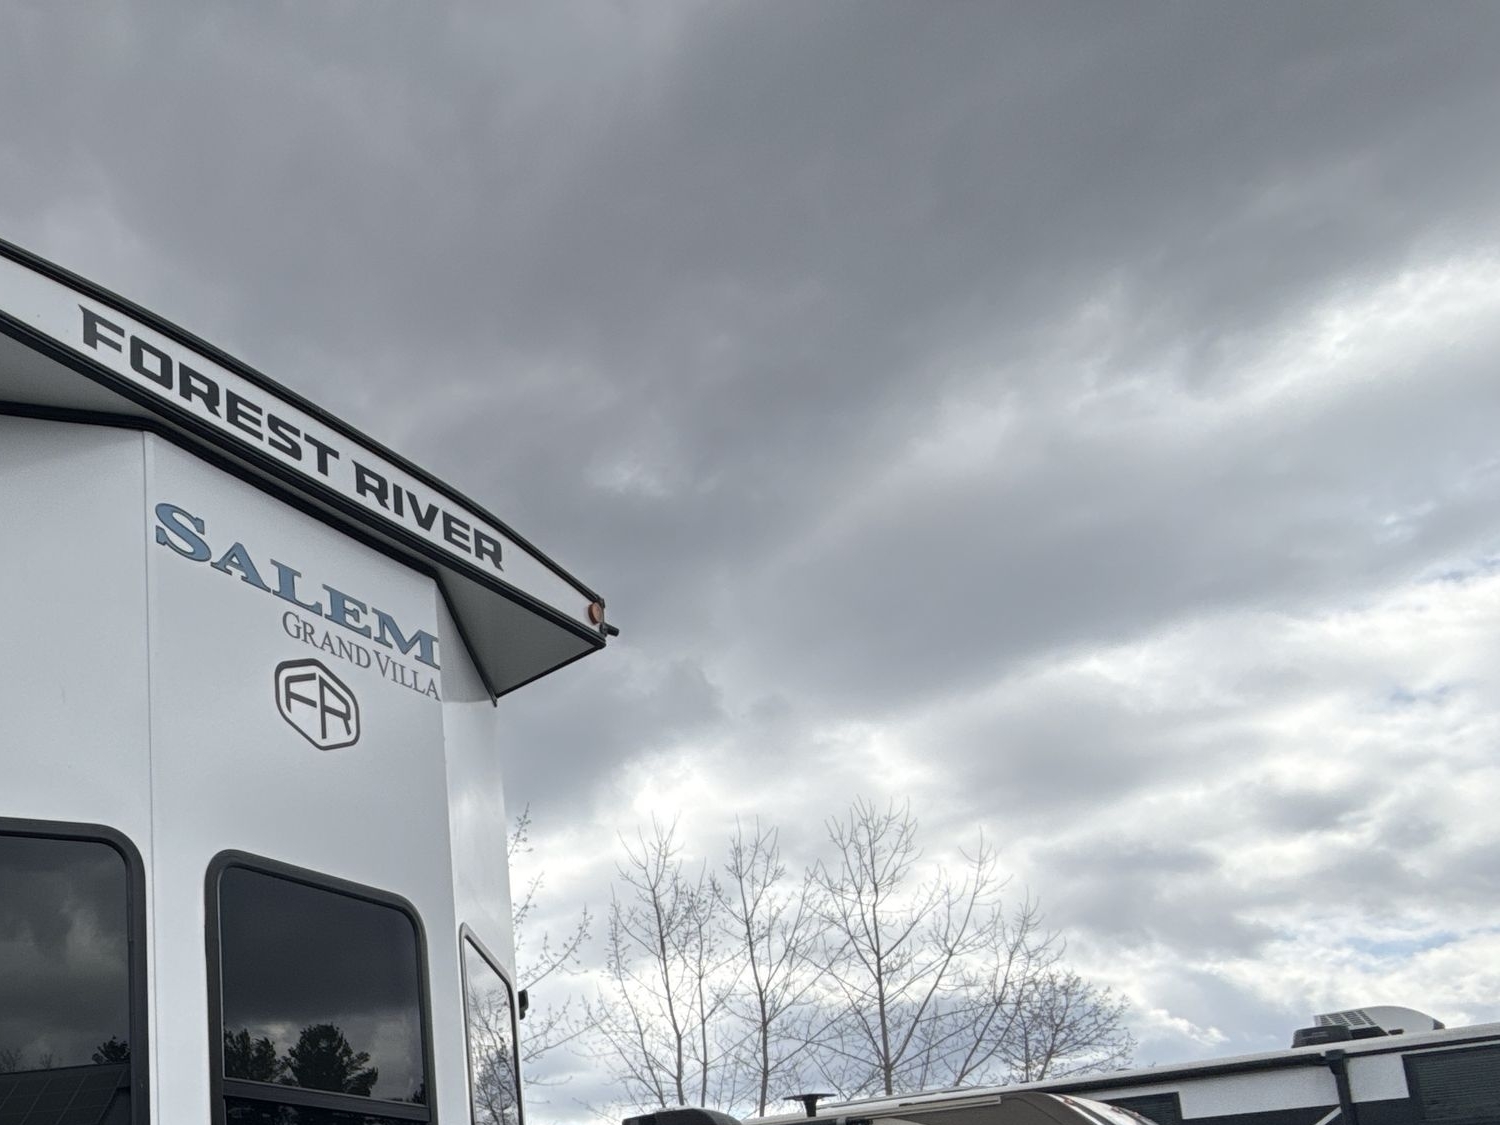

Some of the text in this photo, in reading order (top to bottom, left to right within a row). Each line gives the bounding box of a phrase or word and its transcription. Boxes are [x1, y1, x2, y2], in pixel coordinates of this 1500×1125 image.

[77, 303, 505, 572] FOREST RIVER
[154, 502, 442, 671] SALEM
[282, 610, 442, 702] GRAND VILLA
